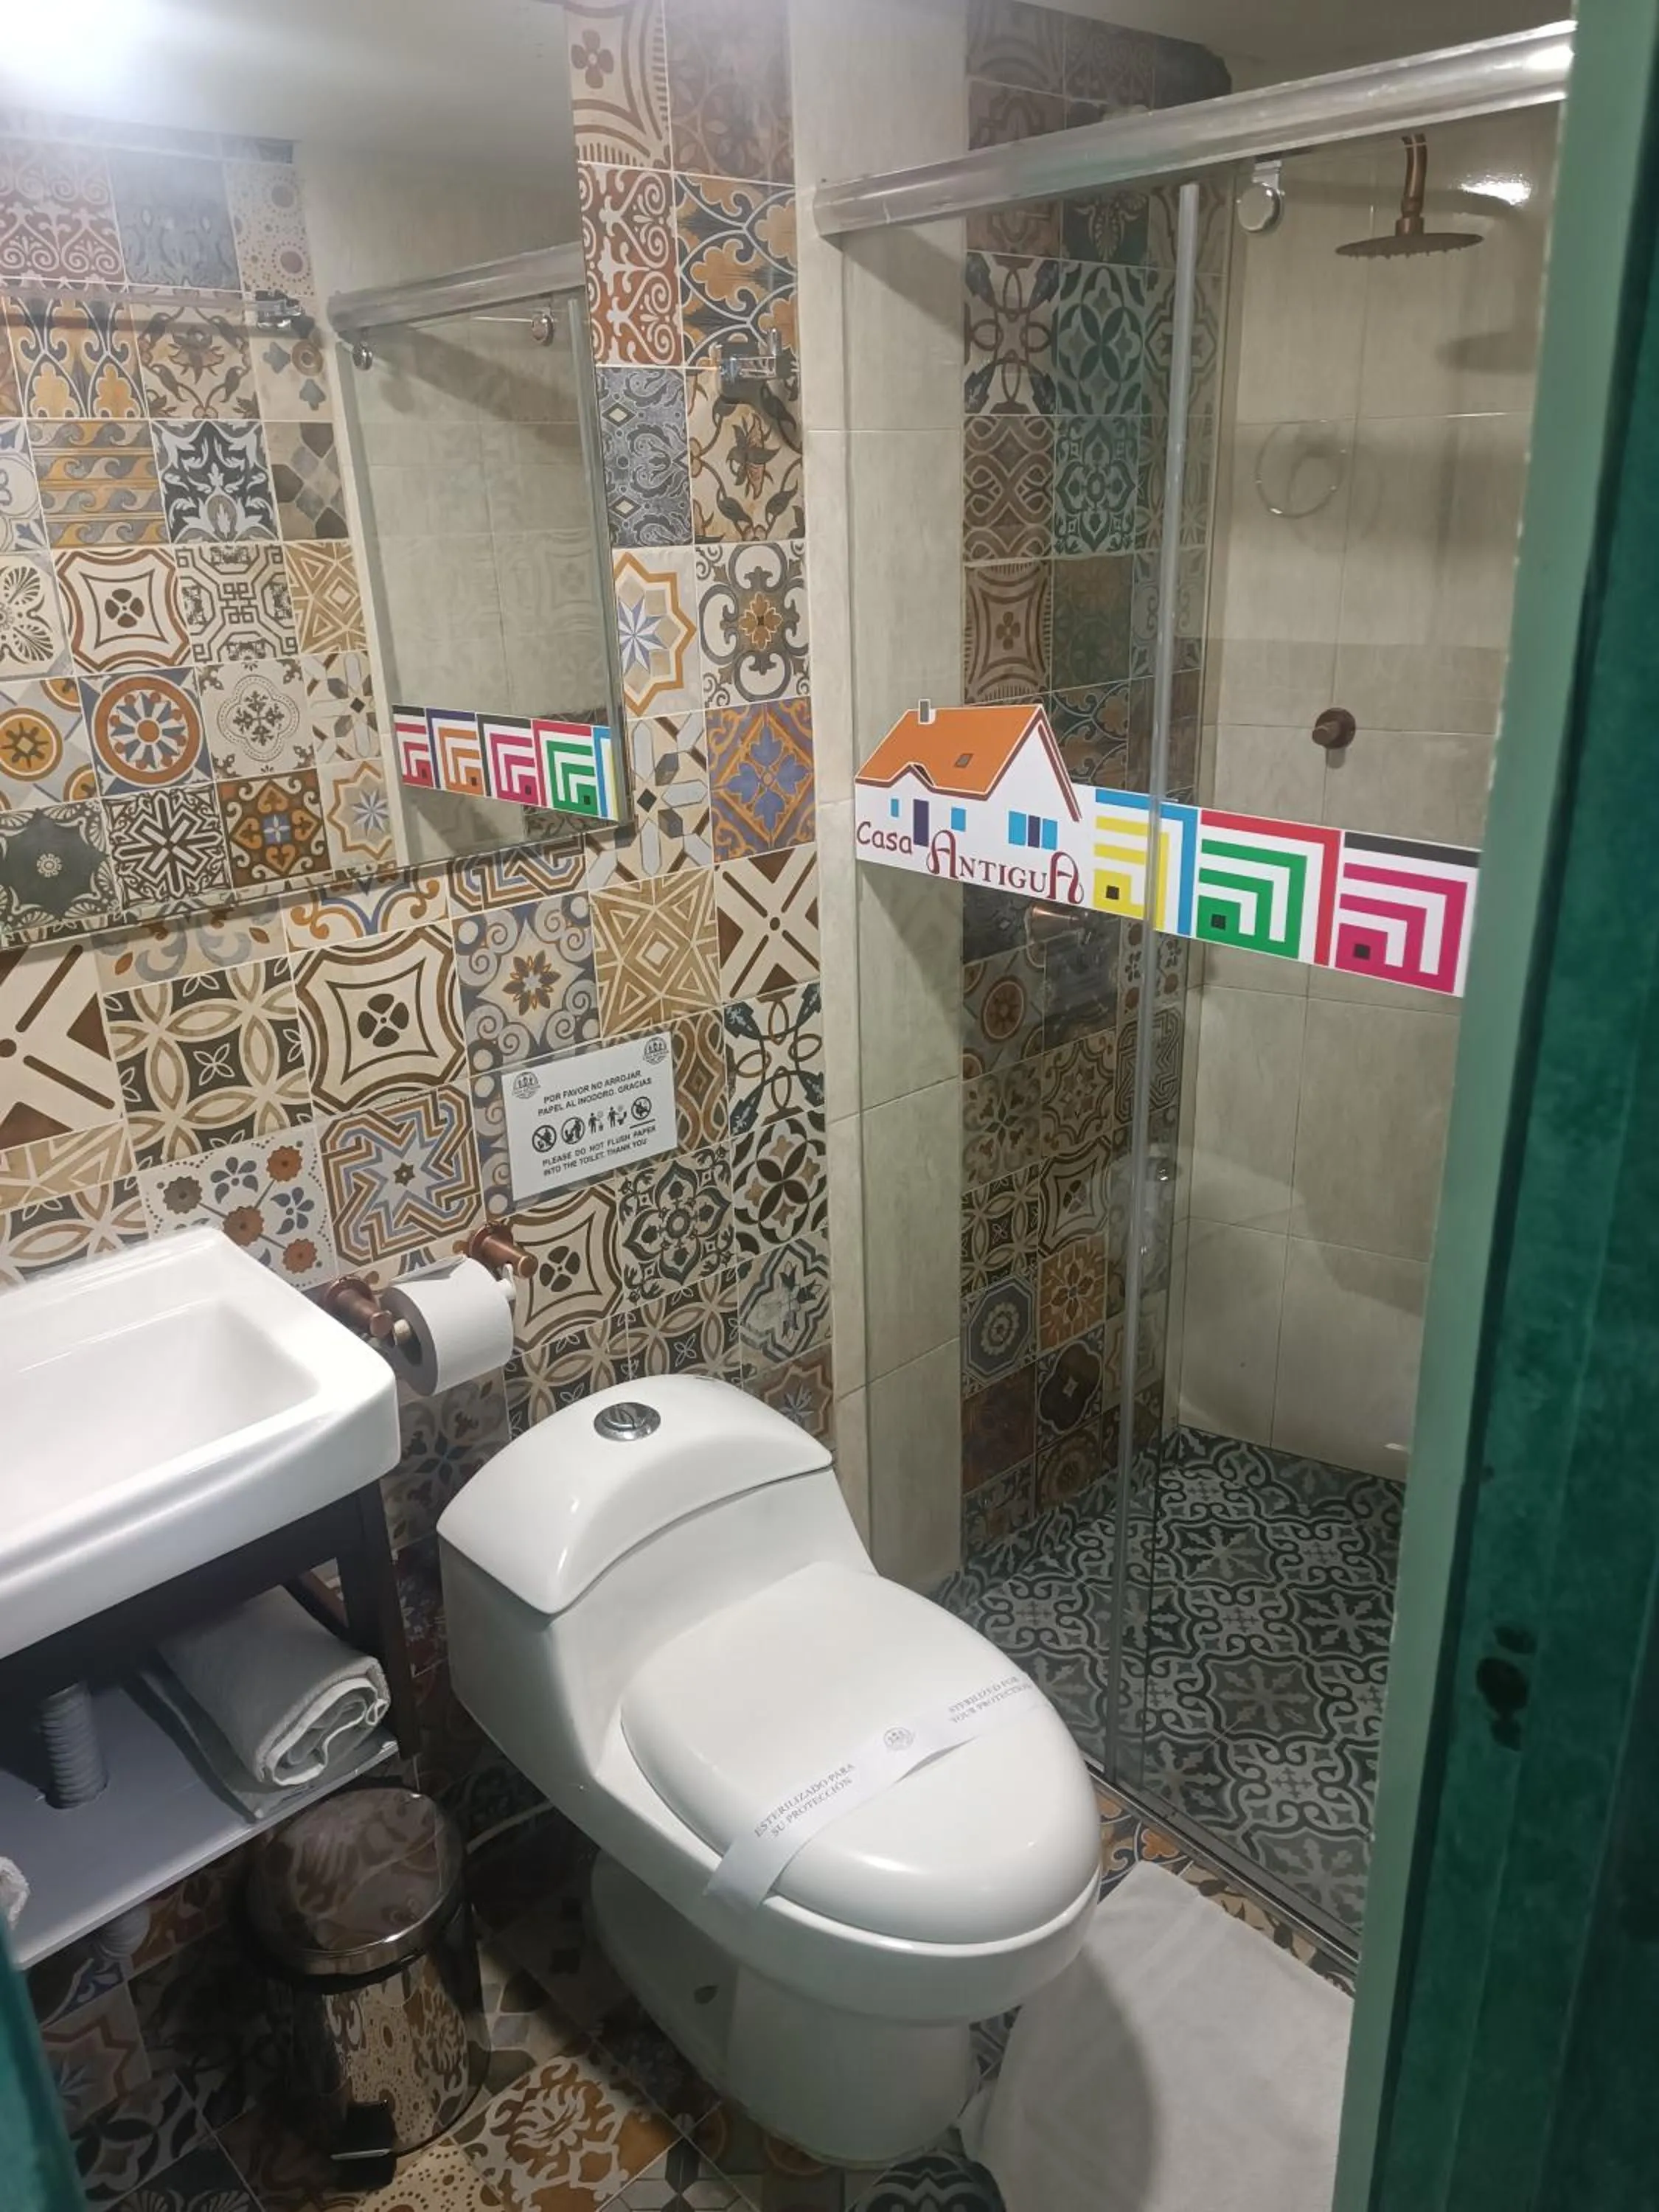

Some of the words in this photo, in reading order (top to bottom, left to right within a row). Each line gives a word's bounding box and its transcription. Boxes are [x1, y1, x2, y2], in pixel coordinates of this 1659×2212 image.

[857, 821, 913, 855] Casa
[538, 1104, 563, 1116] PAPEL
[566, 1099, 577, 1108] AL
[618, 1077, 652, 1093] GRACIAS
[543, 1093, 561, 1104] POR
[563, 1085, 590, 1099] FAVOR
[591, 1081, 603, 1091] NO
[605, 1070, 641, 1087] ARROJAR
[543, 1151, 571, 1166] PLEASE
[574, 1147, 586, 1157] DO
[589, 1141, 605, 1152] NOT
[607, 1134, 630, 1147] FLUSH
[633, 1125, 655, 1138] PAPER
[543, 1166, 561, 1176] INTO
[563, 1160, 577, 1171] THE
[607, 1144, 630, 1157] THANK
[632, 1138, 647, 1148] YOU
[754, 1778, 829, 1837] ESTERILIZADO
[828, 1763, 855, 1781] PARA
[770, 1821, 786, 1838] SU
